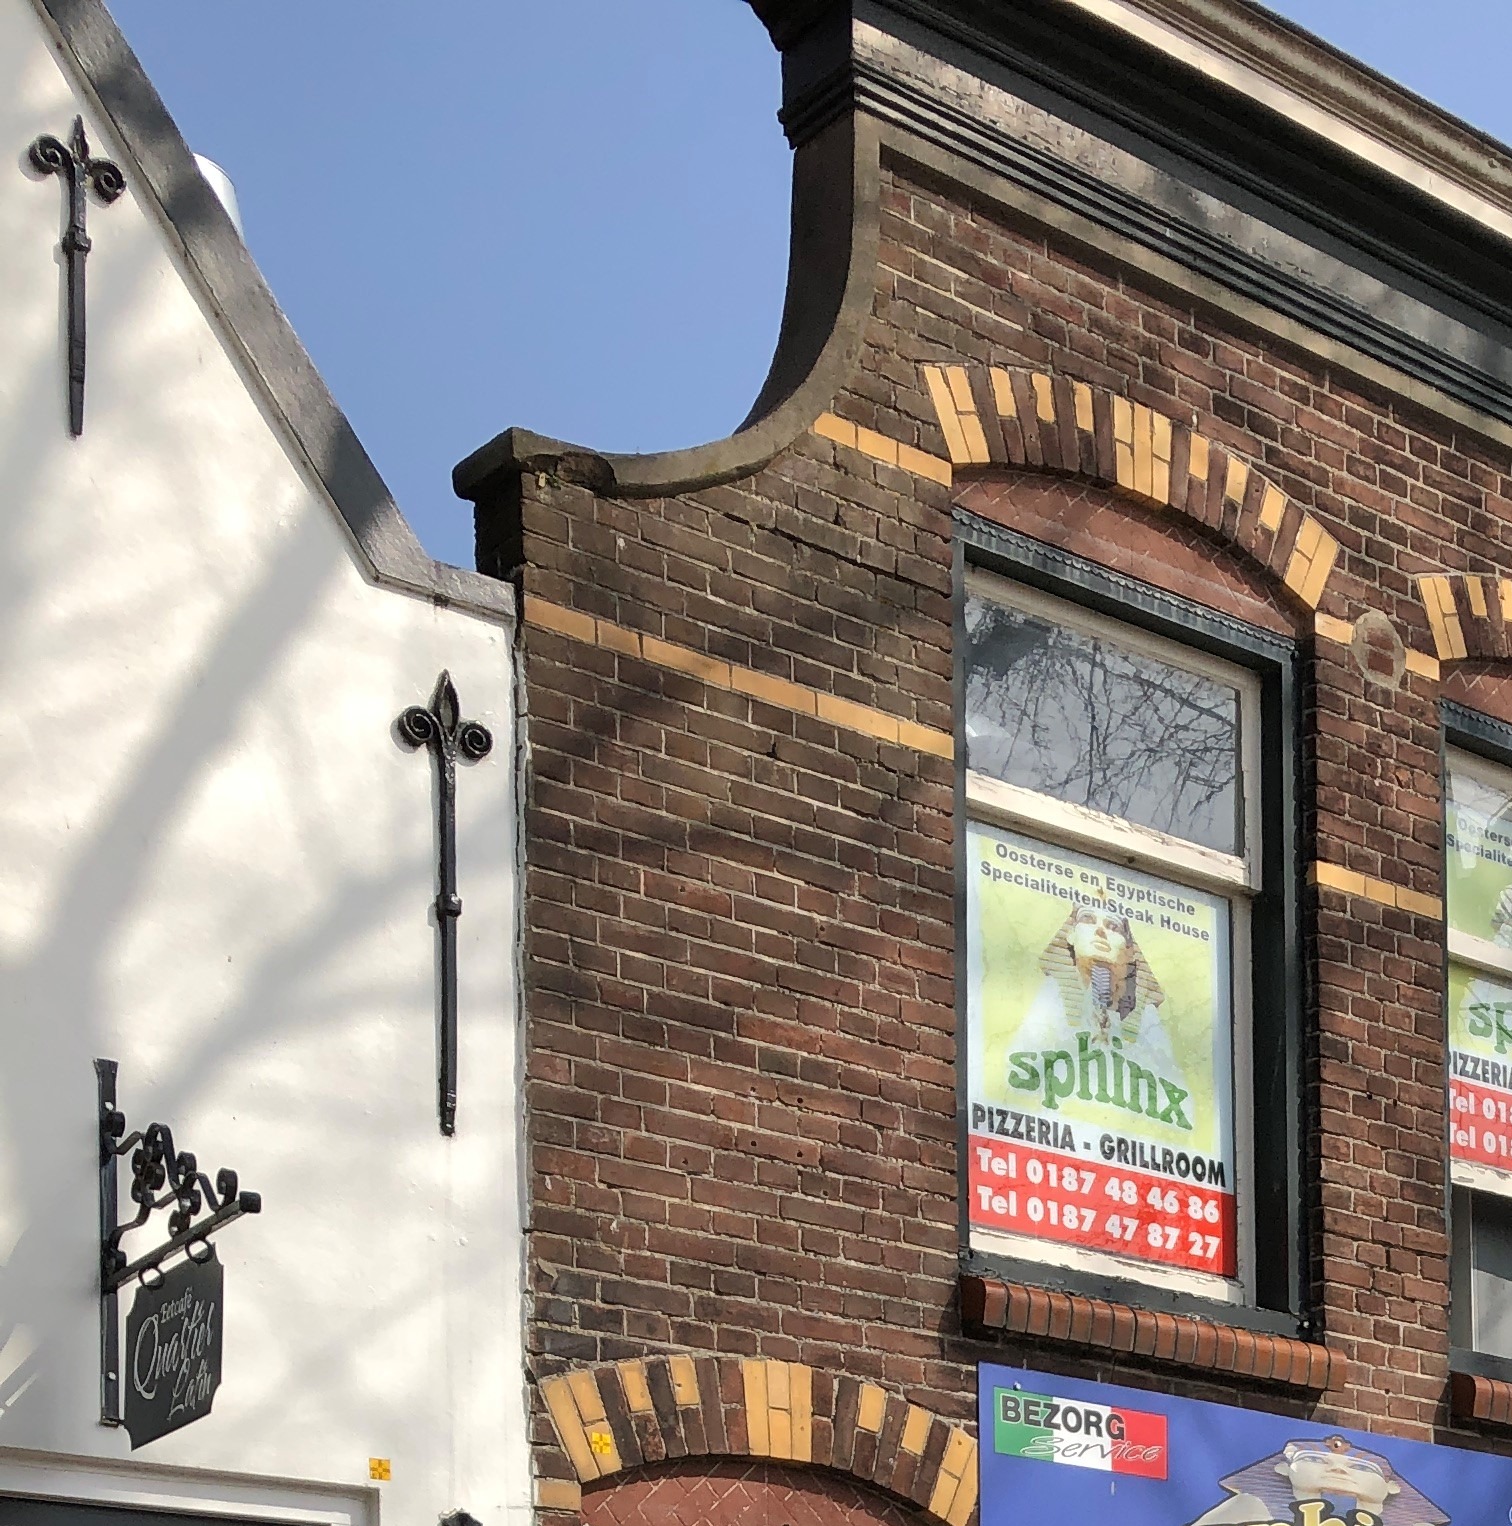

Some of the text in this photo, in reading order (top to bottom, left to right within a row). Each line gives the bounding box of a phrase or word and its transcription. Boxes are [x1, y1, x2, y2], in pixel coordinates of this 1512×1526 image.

[995, 843, 1196, 916] Oosterse en Egyptische
[1160, 914, 1210, 942] House
[1007, 1031, 1194, 1131] sphinx
[972, 1102, 1076, 1153] PIZZERIA
[1099, 1133, 1227, 1188] GRILLROOM
[976, 1147, 1220, 1224] Tel 0187 48 46 86
[976, 1185, 1221, 1260] Tel 0187 47 87 27
[167, 1358, 212, 1421] Latin
[1001, 1394, 1125, 1441] BEZORG
[1020, 1435, 1163, 1462] Service
